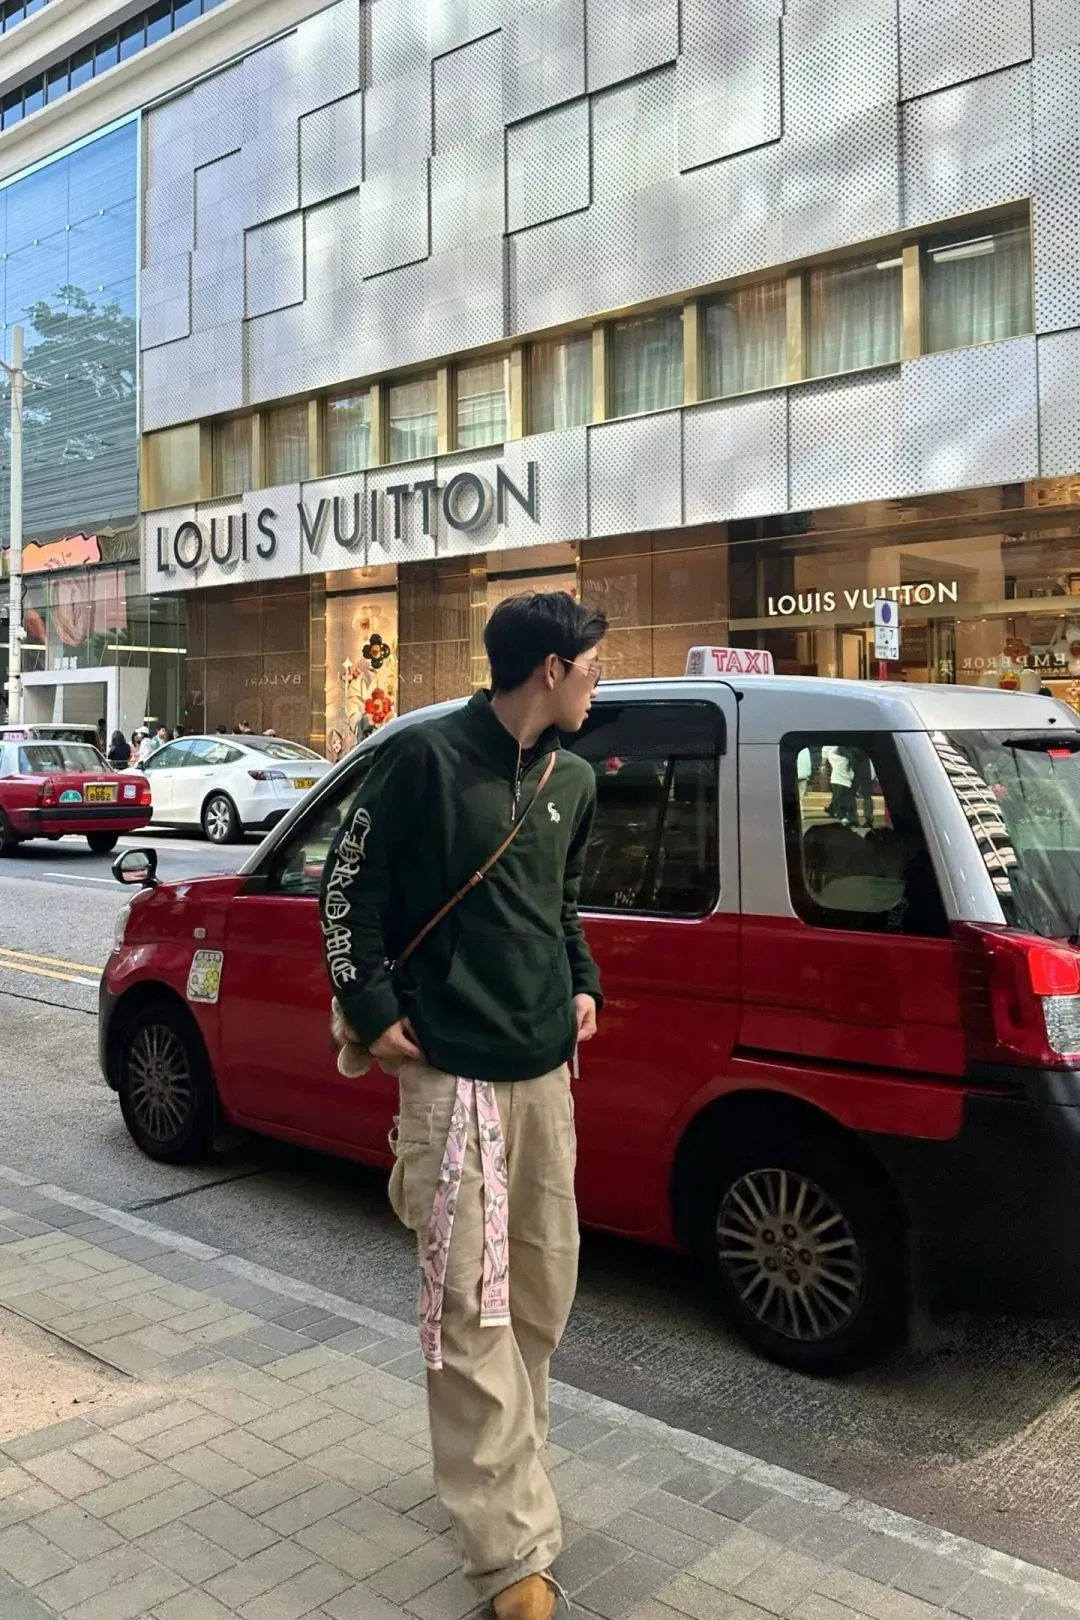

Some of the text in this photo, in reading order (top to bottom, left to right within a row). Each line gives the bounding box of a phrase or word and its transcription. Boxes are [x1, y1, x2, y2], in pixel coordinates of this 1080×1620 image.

[157, 461, 539, 572] LOUIS VUITTON
[768, 581, 957, 615] LOUIS VUITTON
[712, 649, 769, 674] TAXI
